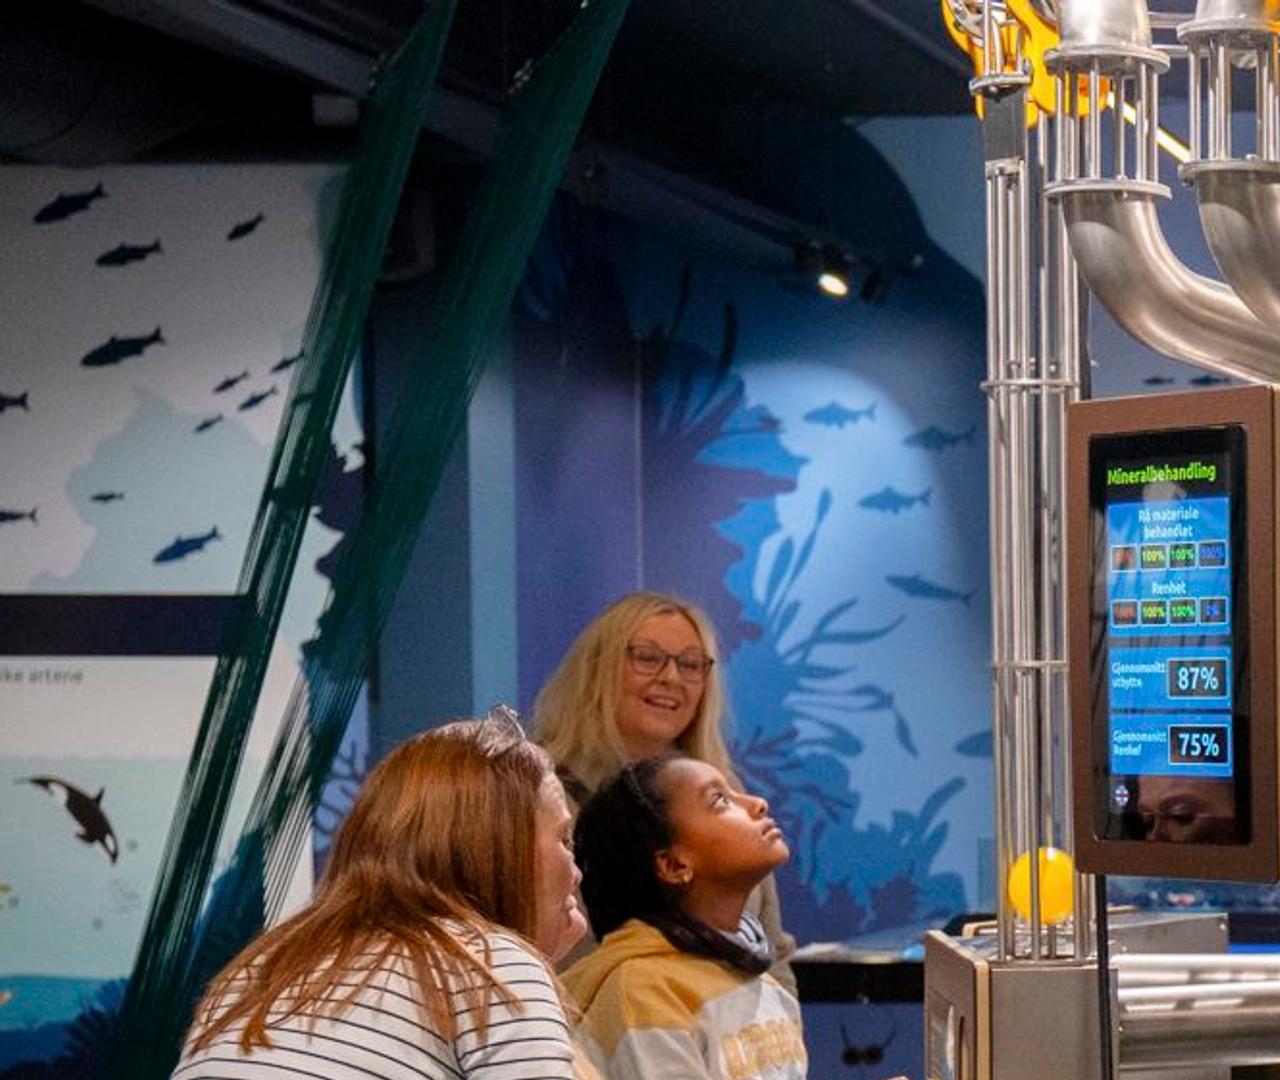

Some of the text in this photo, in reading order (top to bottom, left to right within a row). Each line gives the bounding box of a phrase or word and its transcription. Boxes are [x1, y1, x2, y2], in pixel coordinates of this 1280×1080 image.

[1107, 461, 1217, 486] Mineralbehandling
[1152, 504, 1200, 522] materiale
[1143, 524, 1194, 540] behandlet
[1151, 580, 1187, 596] Renhet
[1141, 605, 1166, 618] 100%
[1170, 604, 1195, 618] 100%
[1177, 666, 1220, 691] 87%
[1178, 733, 1221, 757] 75%
